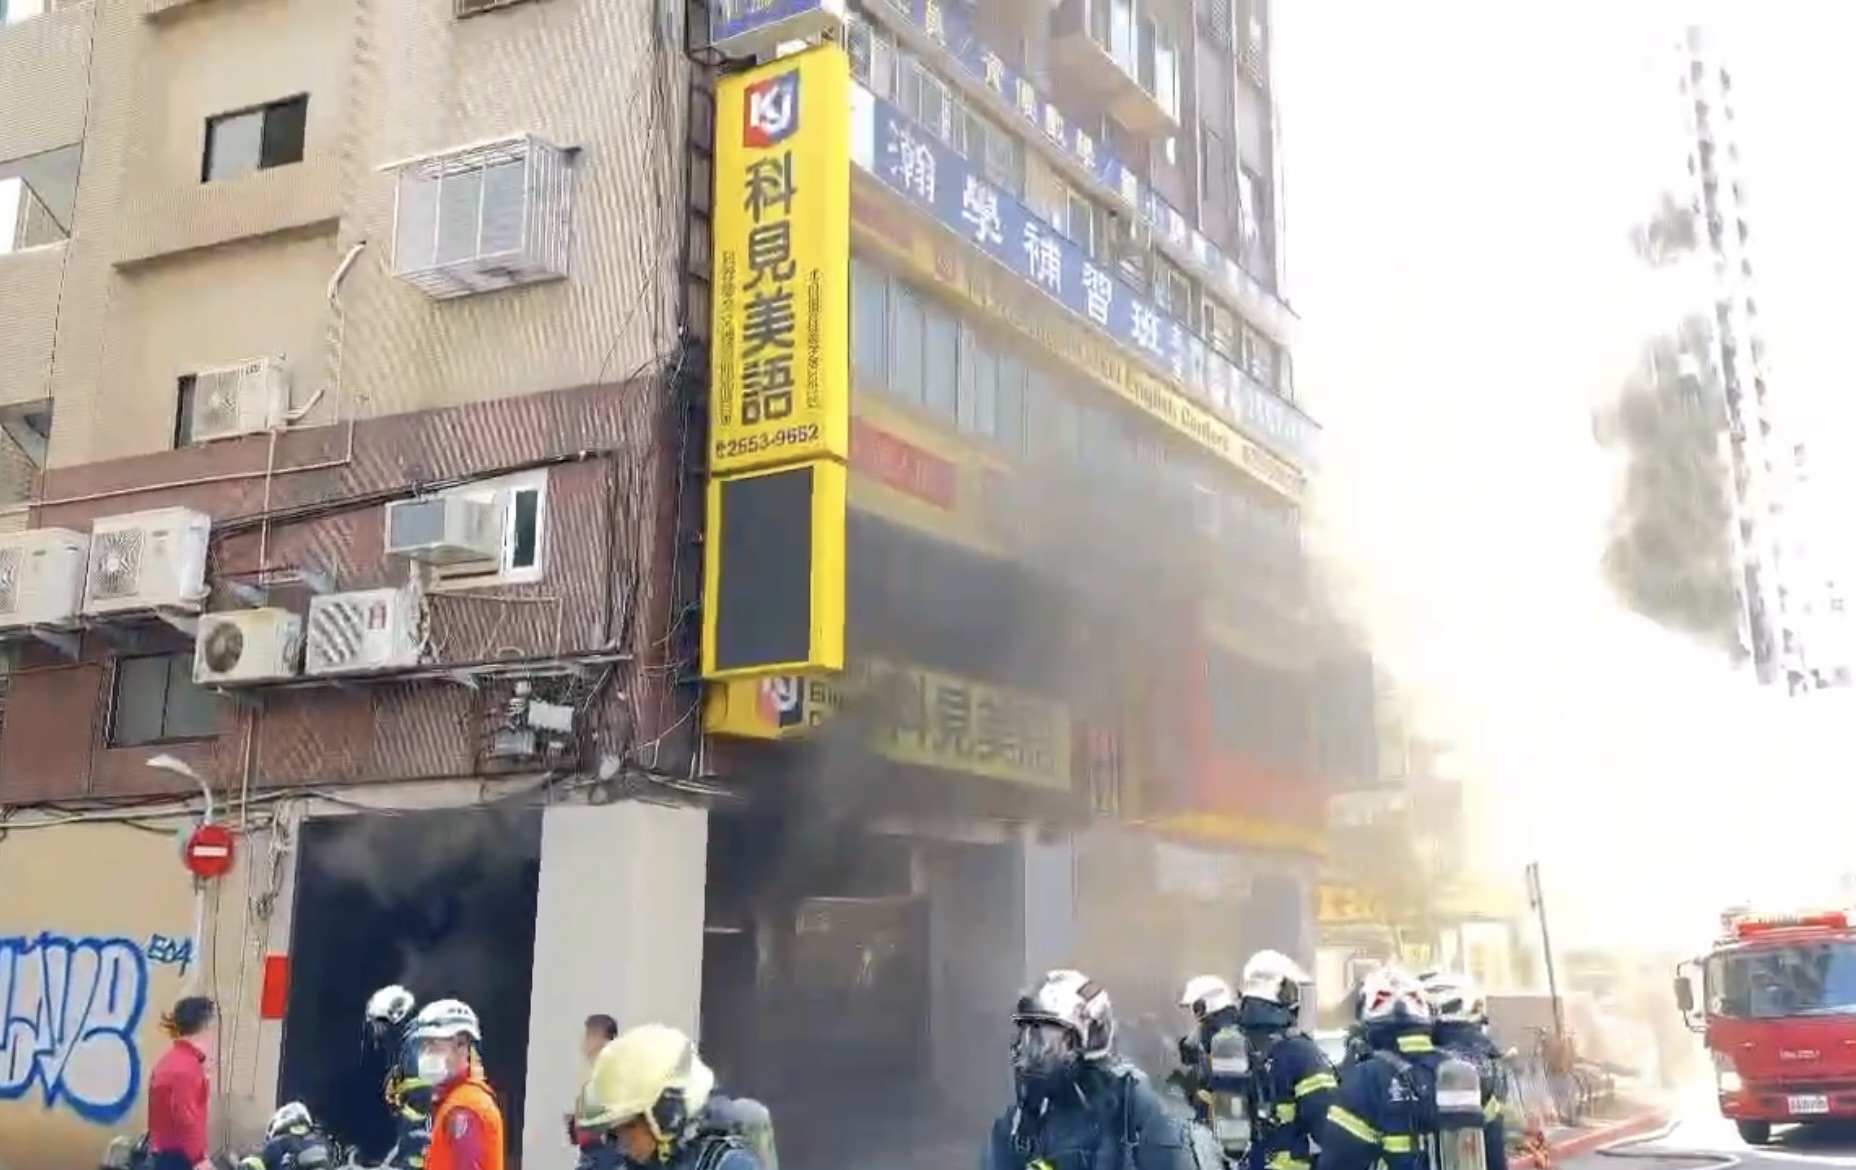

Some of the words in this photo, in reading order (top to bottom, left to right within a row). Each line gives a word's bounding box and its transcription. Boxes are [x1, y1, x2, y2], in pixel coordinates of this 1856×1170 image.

[751, 83, 792, 133] KJ
[741, 150, 797, 426] 科見美語
[887, 120, 1163, 356] 瀚學補習班
